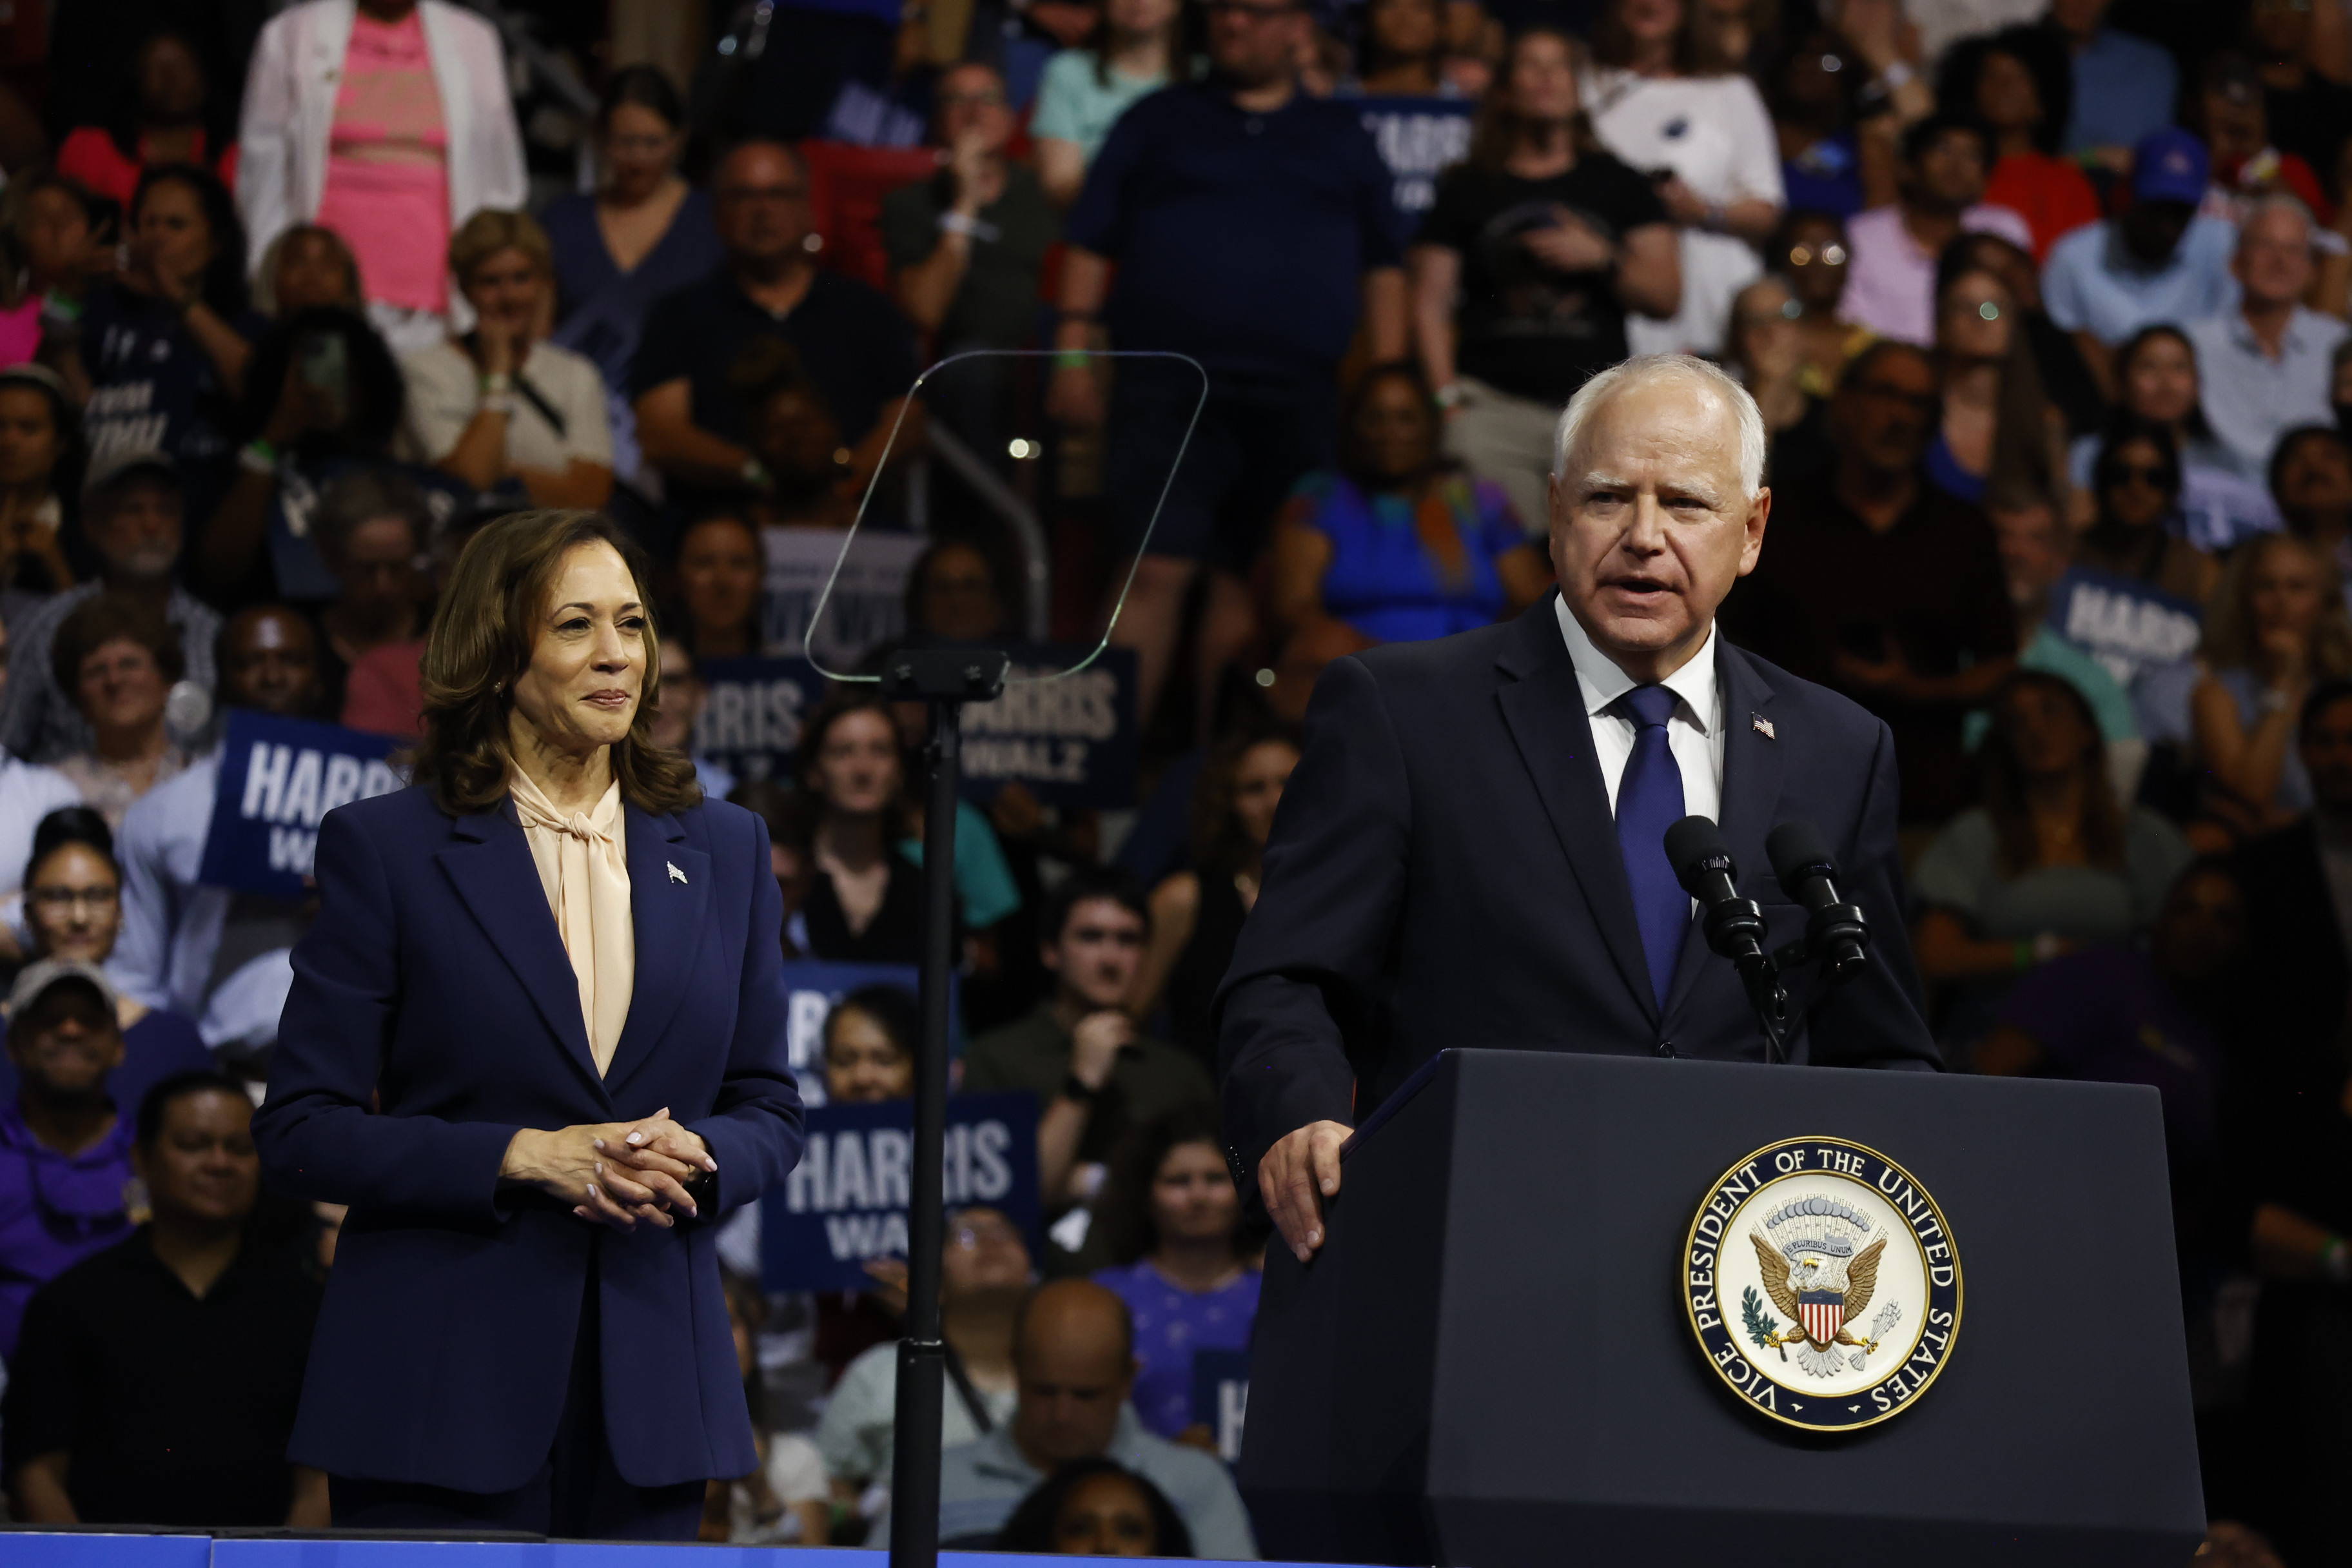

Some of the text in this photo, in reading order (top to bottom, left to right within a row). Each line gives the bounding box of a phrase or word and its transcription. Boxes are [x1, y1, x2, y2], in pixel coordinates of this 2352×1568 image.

[241, 741, 413, 826] HARR
[960, 741, 1088, 781] WALZ
[787, 1120, 1012, 1213] HARIS
[825, 1216, 909, 1260] WA
[1792, 1240, 1827, 1250] PLURIBUS
[1830, 1245, 1852, 1254] UNUM
[1690, 1148, 1954, 1412] VICE PRESIDENT OF THE UNITED STATES
